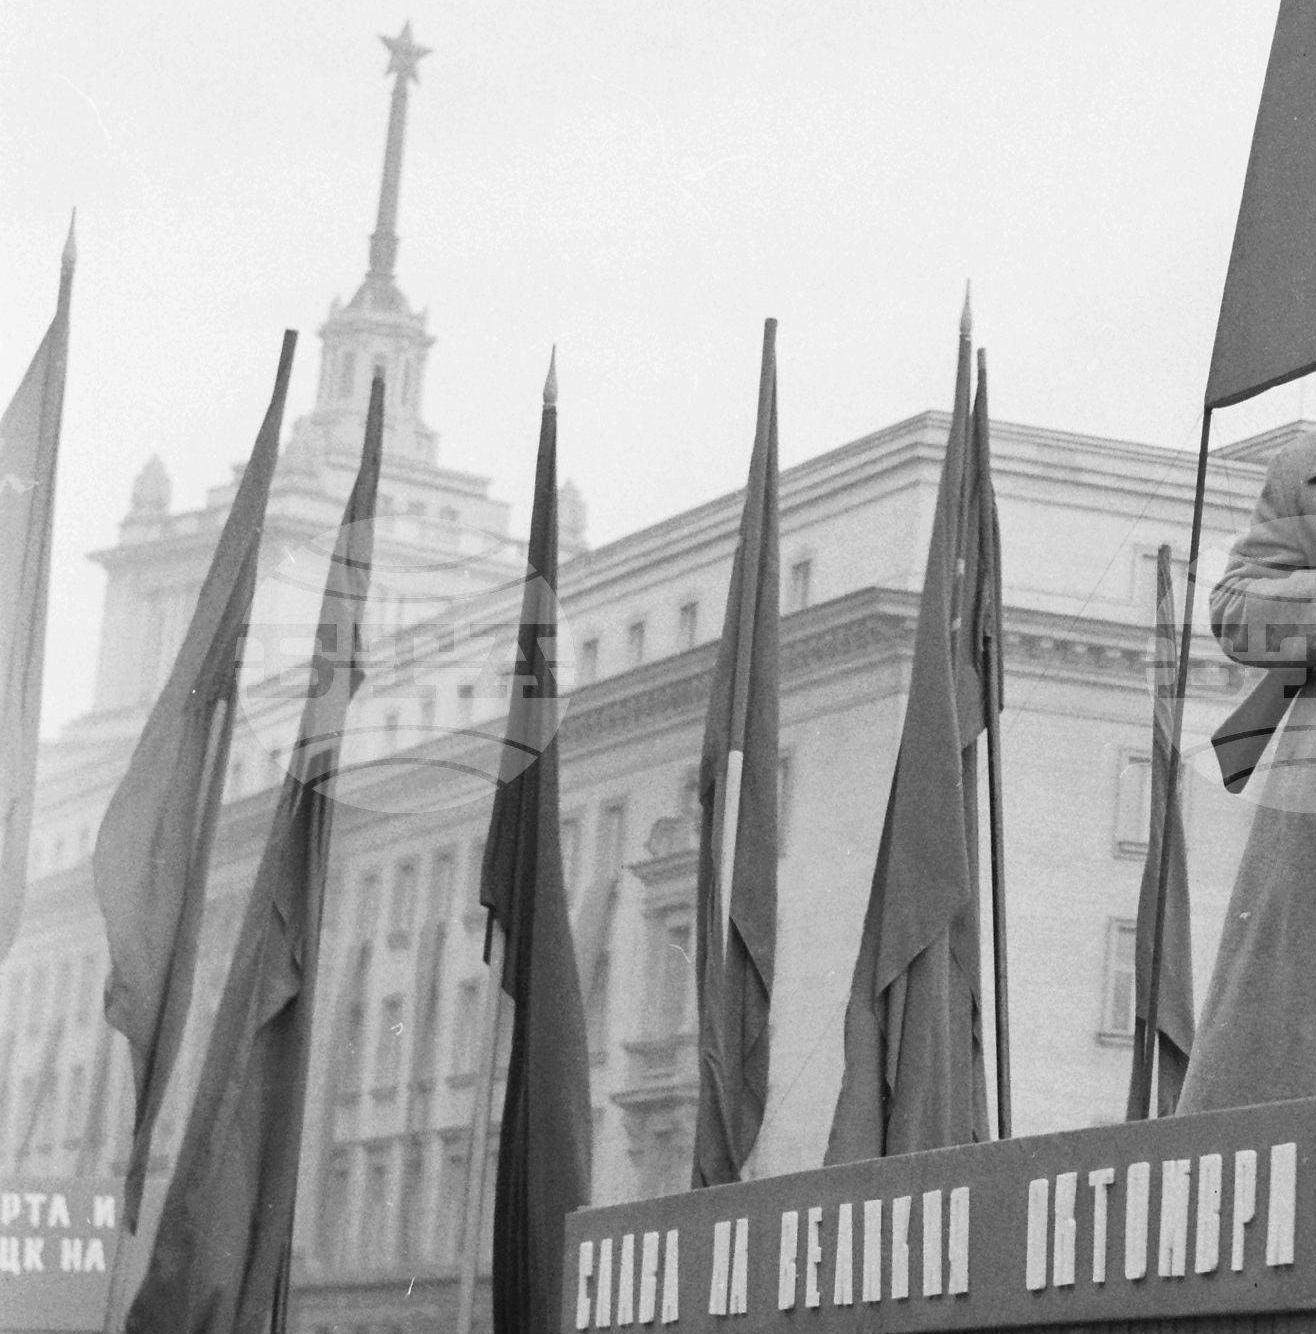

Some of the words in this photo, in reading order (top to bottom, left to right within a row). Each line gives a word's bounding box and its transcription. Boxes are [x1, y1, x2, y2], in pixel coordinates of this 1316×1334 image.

[93, 1195, 116, 1229] И
[576, 1228, 679, 1330] СЛАВА
[708, 1218, 749, 1316] НА
[778, 1186, 971, 1311] ВЕЛИКИЯ
[1025, 1141, 1297, 1292] ОКТОМВРИ
[60, 1237, 106, 1273] НА
